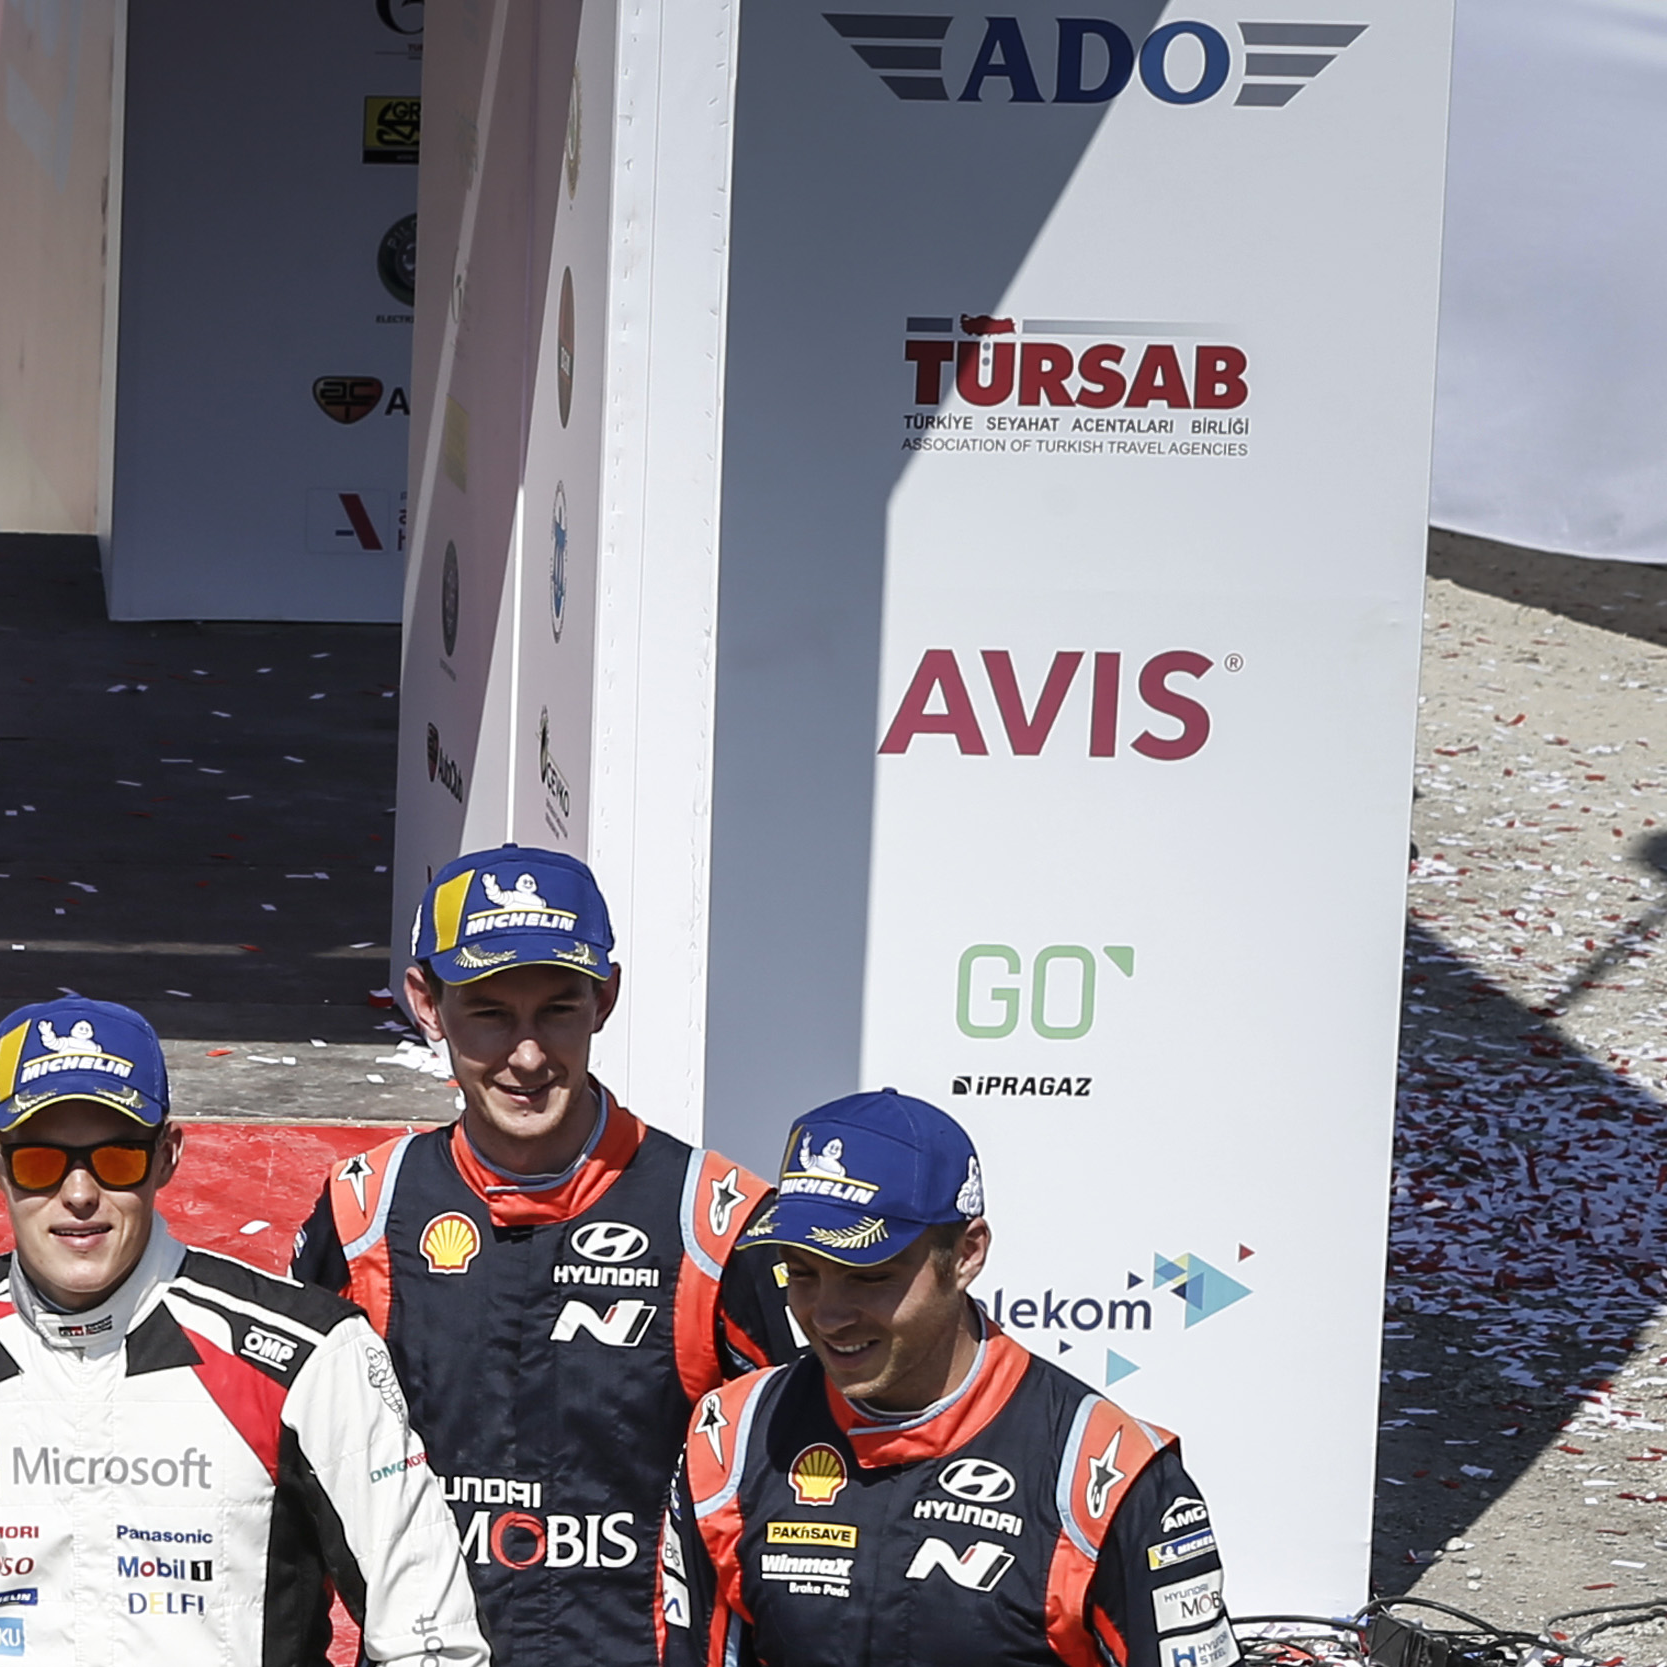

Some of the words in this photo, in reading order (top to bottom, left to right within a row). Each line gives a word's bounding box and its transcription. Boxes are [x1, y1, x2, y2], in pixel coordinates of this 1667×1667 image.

[957, 17, 1231, 106] ADO
[904, 339, 1249, 410] TÜRSAB
[903, 413, 973, 431] TÜRKİYE
[986, 416, 1060, 432] SEYAHAT
[1071, 417, 1174, 434] ACENTALARI
[1191, 416, 1250, 436] BİRLİĞİ
[901, 437, 1006, 453] ASSOCIATION
[1010, 439, 1032, 453] OF
[1036, 439, 1103, 454] TURKISH
[1107, 440, 1166, 455] TRAVEL
[1167, 442, 1249, 457] AGENCIES
[464, 912, 578, 937] MICHELIN
[953, 943, 1096, 1042] GO
[20, 1058, 132, 1083] MICHELIN
[554, 1264, 659, 1288] HYUNDAI
[242, 1331, 295, 1364] OMP
[11, 1446, 213, 1490] Microsoft
[913, 1500, 1023, 1537] HYUNDAI
[1163, 1506, 1208, 1534] AMG
[116, 1525, 213, 1544] Panasonic
[117, 1556, 186, 1581] Mobil
[760, 1553, 853, 1578] Winmax
[788, 1582, 821, 1596] Brake
[823, 1584, 850, 1598] Pads
[128, 1592, 205, 1616] DELFI
